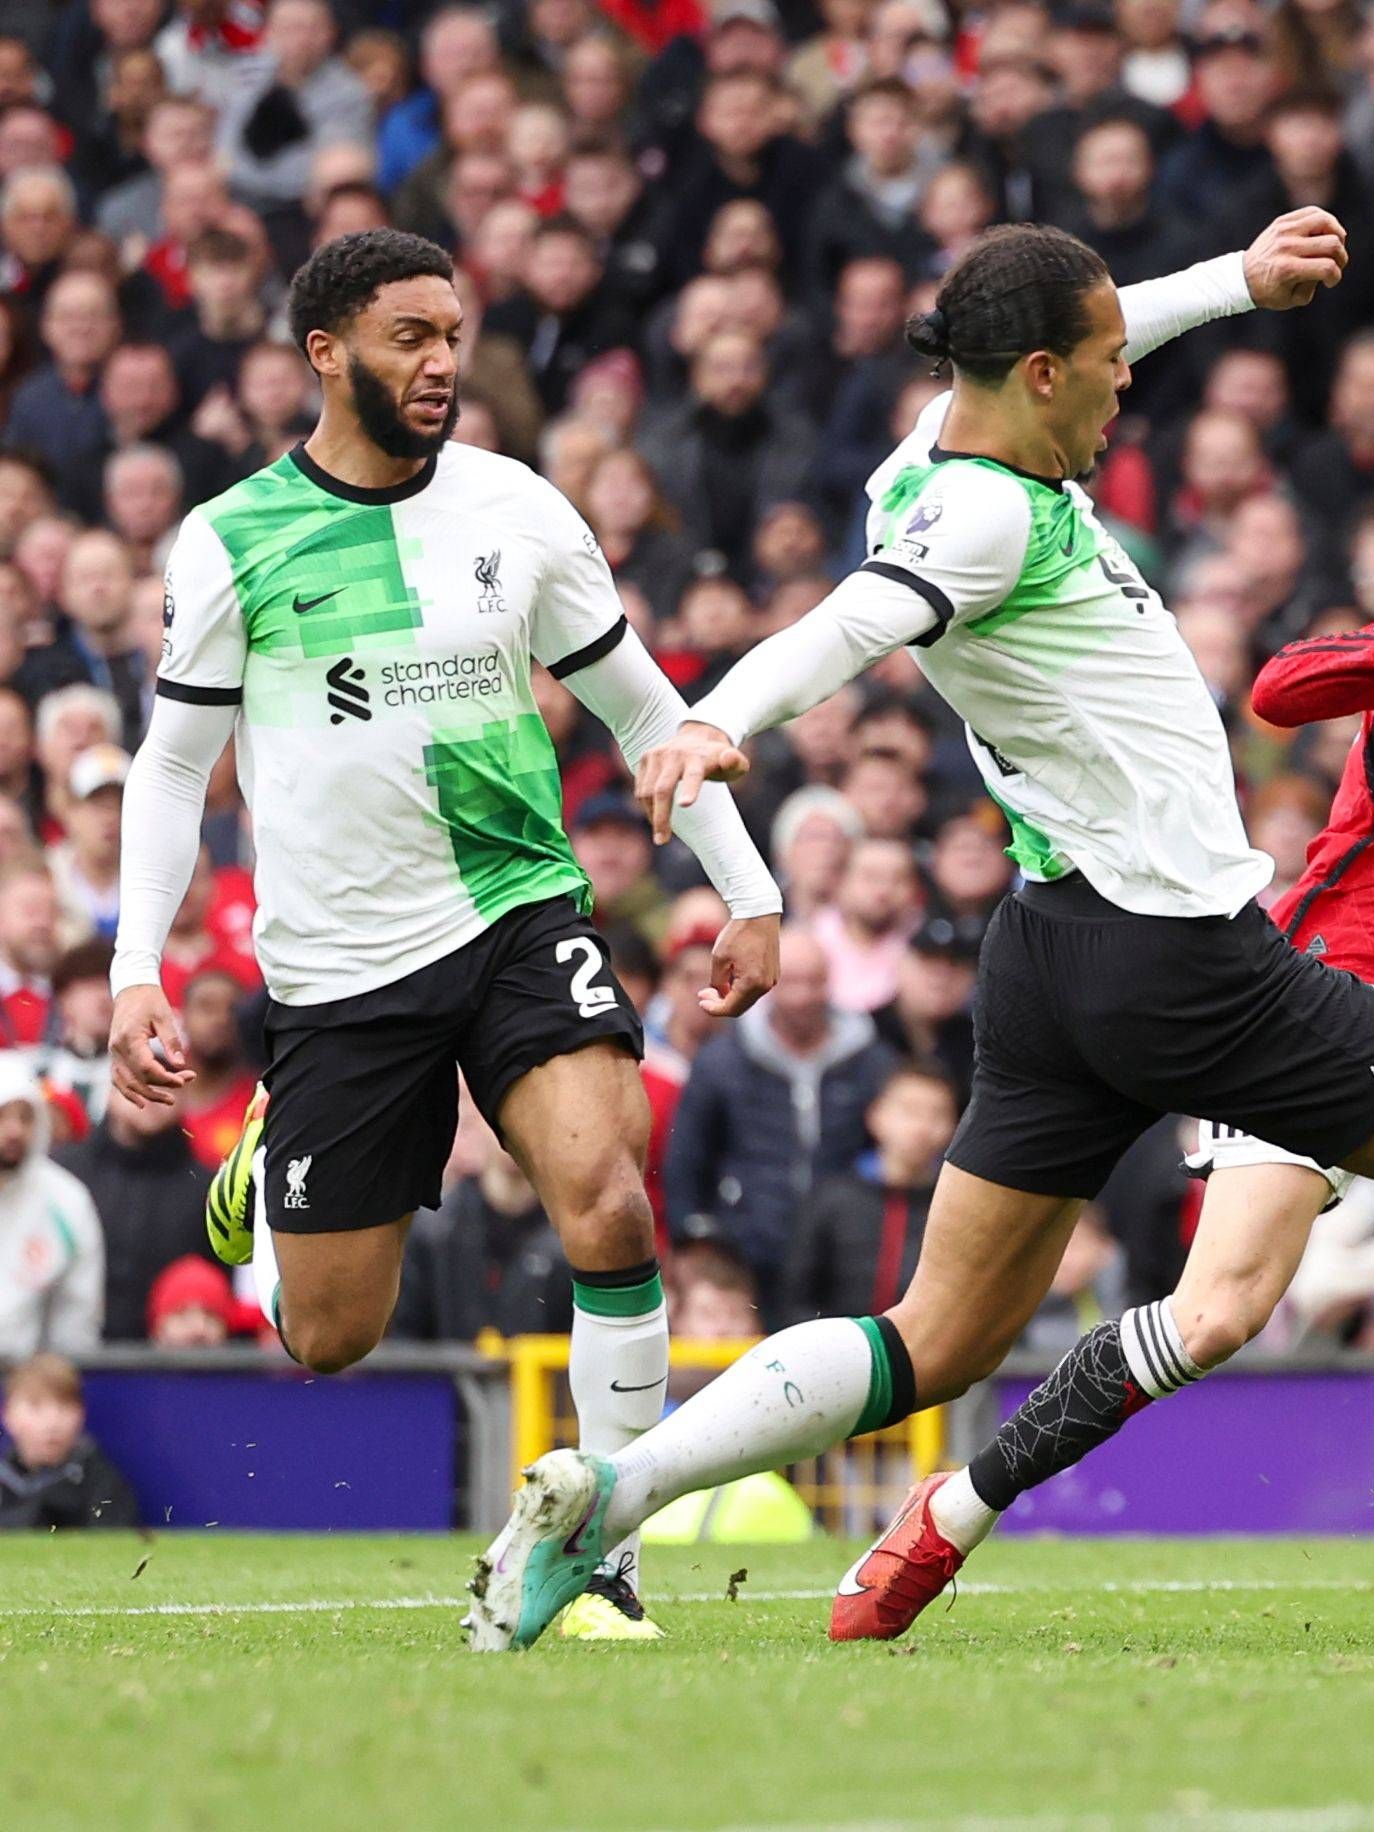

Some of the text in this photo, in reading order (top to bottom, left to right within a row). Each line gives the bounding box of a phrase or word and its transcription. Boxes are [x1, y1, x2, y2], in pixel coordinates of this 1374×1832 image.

[381, 650, 499, 685] standard
[384, 672, 503, 707] chartered
[556, 936, 616, 1004] 2
